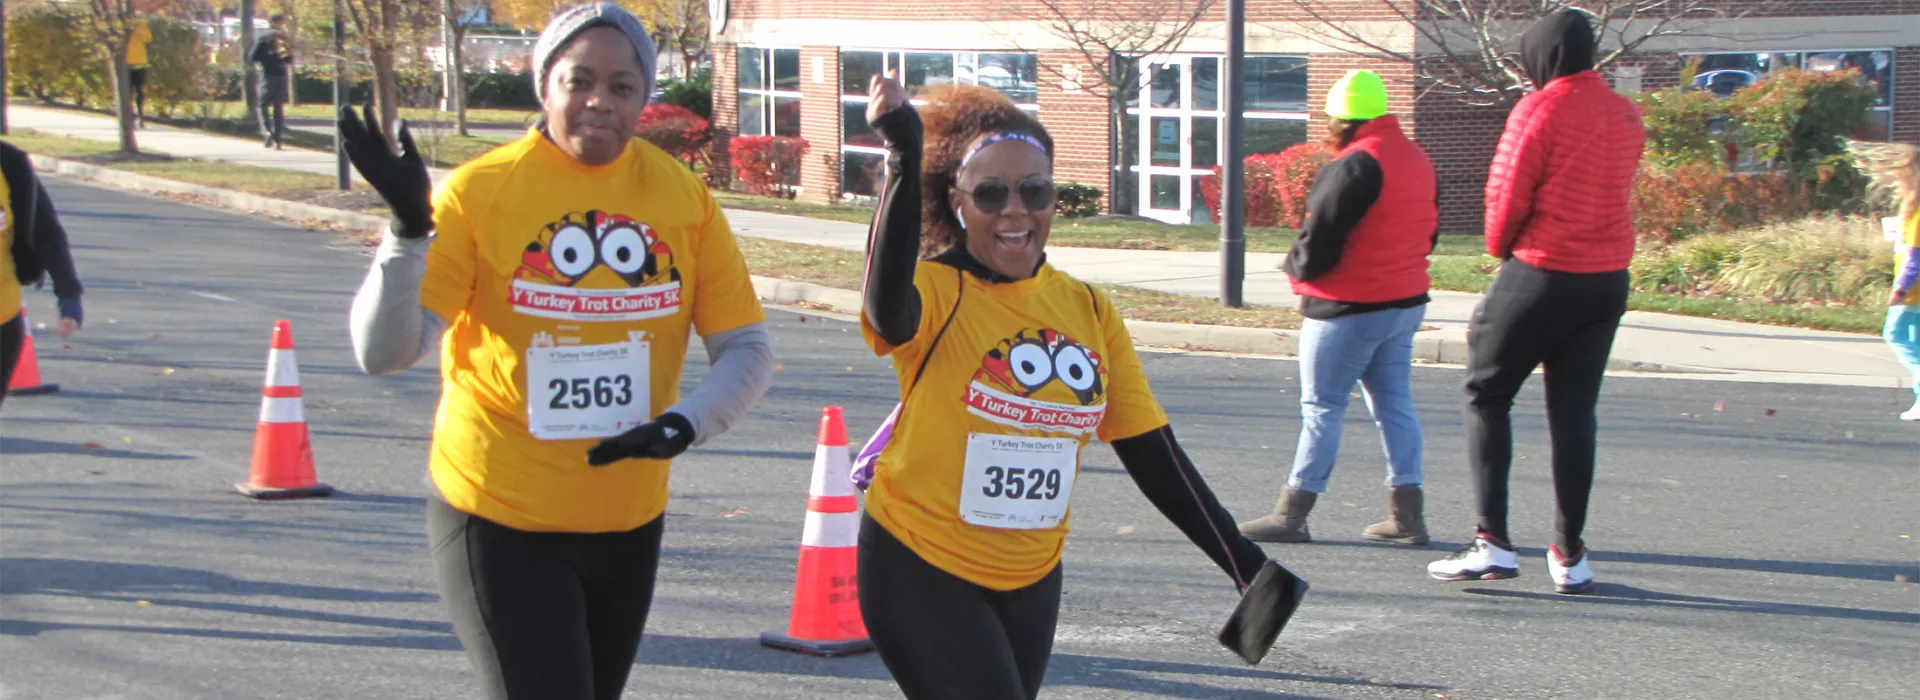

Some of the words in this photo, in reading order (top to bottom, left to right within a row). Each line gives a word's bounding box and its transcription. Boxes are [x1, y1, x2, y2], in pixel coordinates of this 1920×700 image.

[512, 288, 524, 302] Y
[525, 291, 576, 312] Turkey
[579, 297, 609, 311] Trot
[612, 294, 661, 311] Charity
[664, 290, 680, 304] 5K
[548, 374, 632, 410] 2563
[968, 388, 980, 402] Y
[980, 393, 1028, 422] Turkey
[1030, 408, 1058, 424] Trot
[1057, 411, 1098, 427] Charity
[982, 465, 1061, 501] 3529
